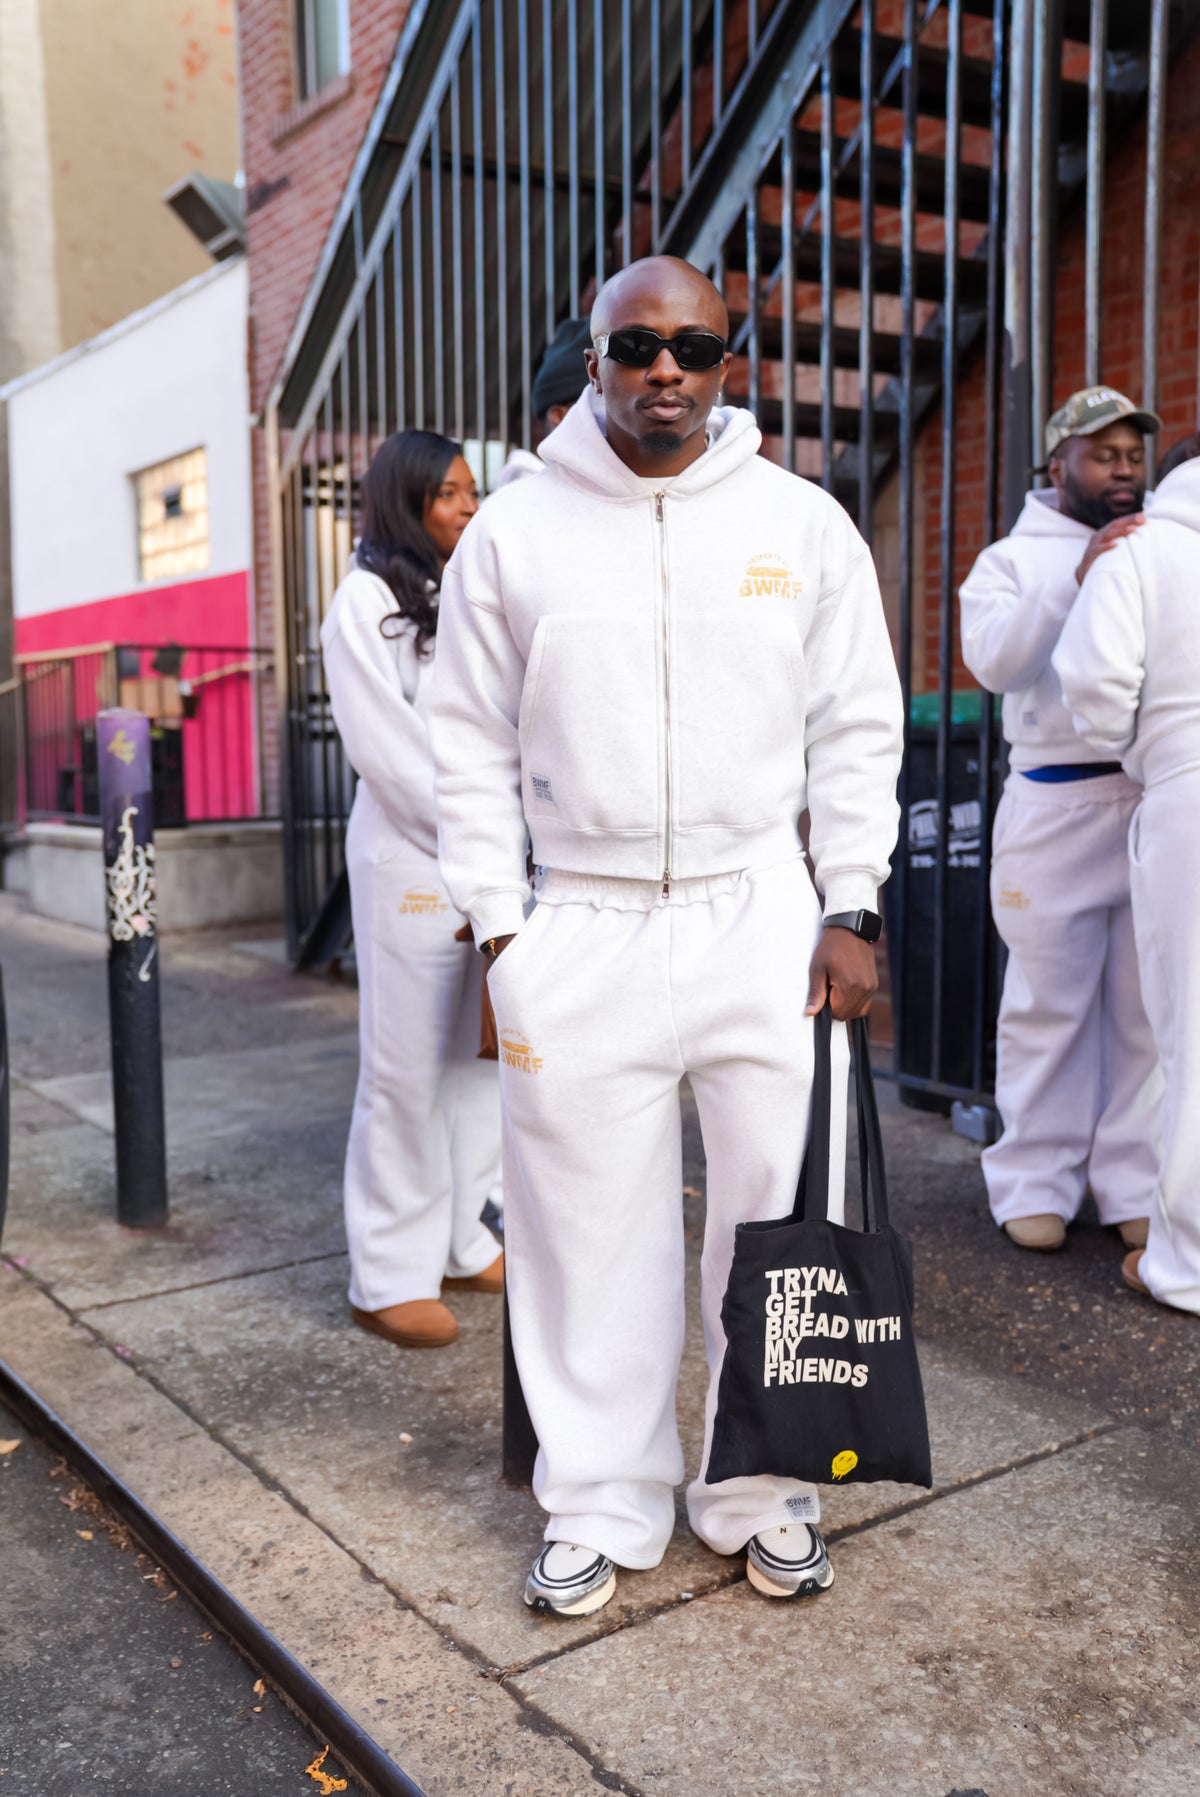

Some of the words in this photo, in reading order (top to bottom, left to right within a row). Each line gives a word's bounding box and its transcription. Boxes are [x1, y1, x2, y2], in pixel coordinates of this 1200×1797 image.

[765, 1266, 848, 1296] TRYNA
[765, 1290, 817, 1317] GET
[766, 1312, 850, 1341] BREAD
[855, 1316, 901, 1344] WITH
[765, 1337, 803, 1363] MY
[764, 1358, 869, 1388] FRIENDS
[785, 1496, 811, 1508] BWMF
